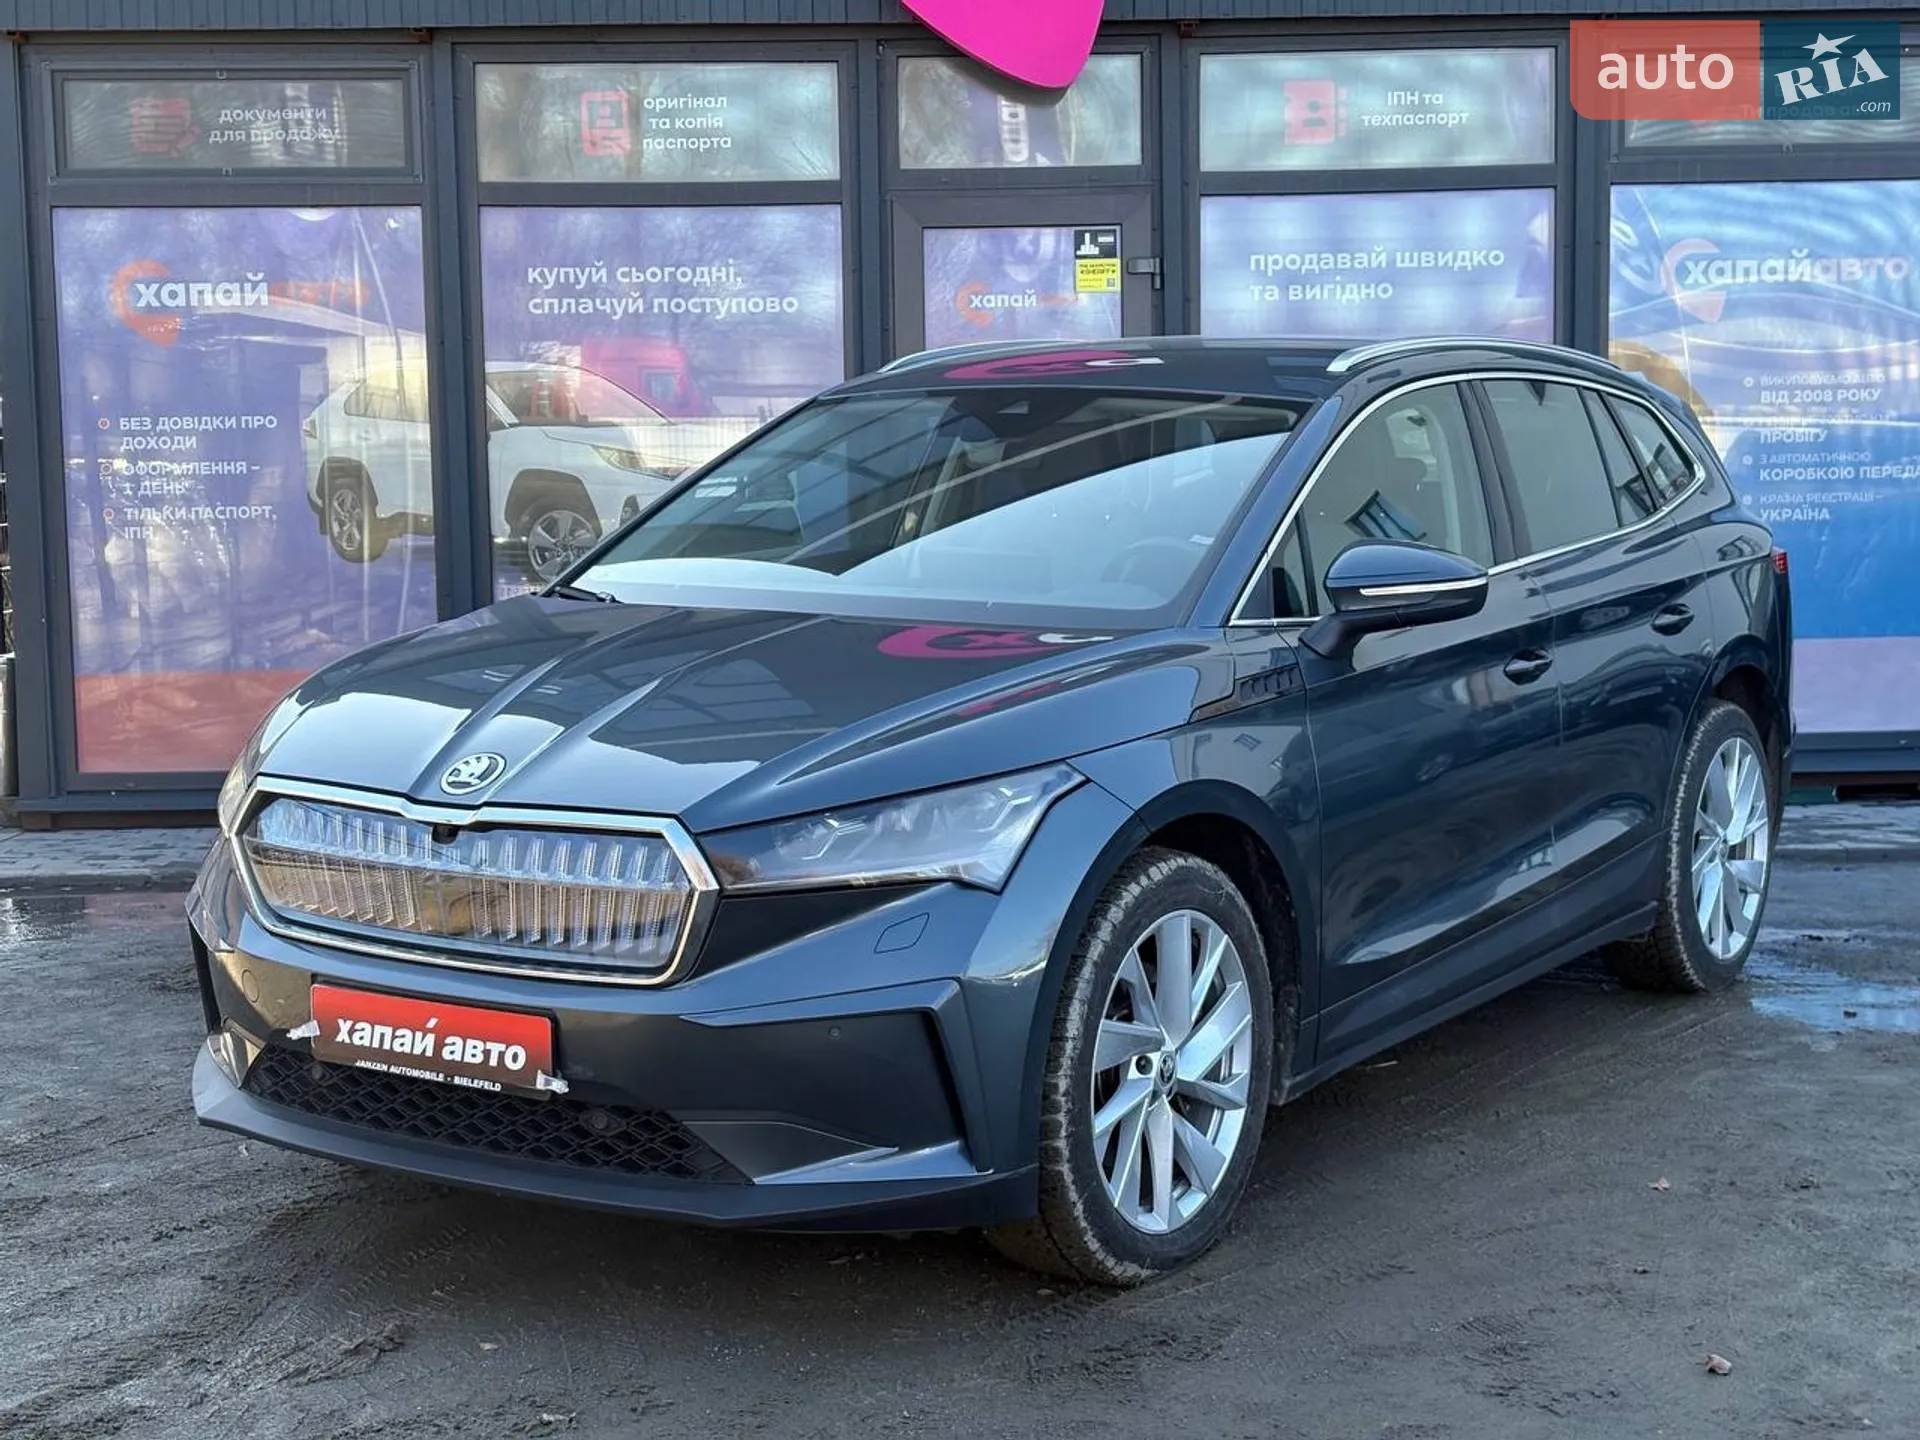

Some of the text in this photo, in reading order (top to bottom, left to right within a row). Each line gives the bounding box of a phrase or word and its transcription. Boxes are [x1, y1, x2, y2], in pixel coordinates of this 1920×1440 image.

[643, 95, 728, 110] оригінал
[1387, 92, 1443, 106] ІПН та
[218, 107, 327, 123] документи
[649, 115, 723, 129] та копія
[1362, 112, 1469, 128] техпаспорт
[209, 130, 246, 144] для
[643, 136, 731, 152] паспорта
[1251, 246, 1505, 275] продавай швидко
[528, 260, 743, 289] купуй сьогодні,
[1252, 277, 1393, 304] та вигідно
[528, 293, 798, 320] сплачуй поступово
[1761, 388, 1881, 404] ВІД 2008 РОКУ
[120, 416, 277, 431] БЕЗ ДОВІДКИ ПРО
[120, 436, 197, 452] ДОХОДИ
[1760, 466, 1854, 481] КОРОБКОЮ
[124, 506, 186, 520] ТІЛЬКИ
[1760, 504, 1831, 521] УКРАЇНА
[441, 1036, 527, 1071] авто
[389, 1064, 445, 1082] AUTOMOBILE
[453, 1075, 502, 1092] BIELEFELD
